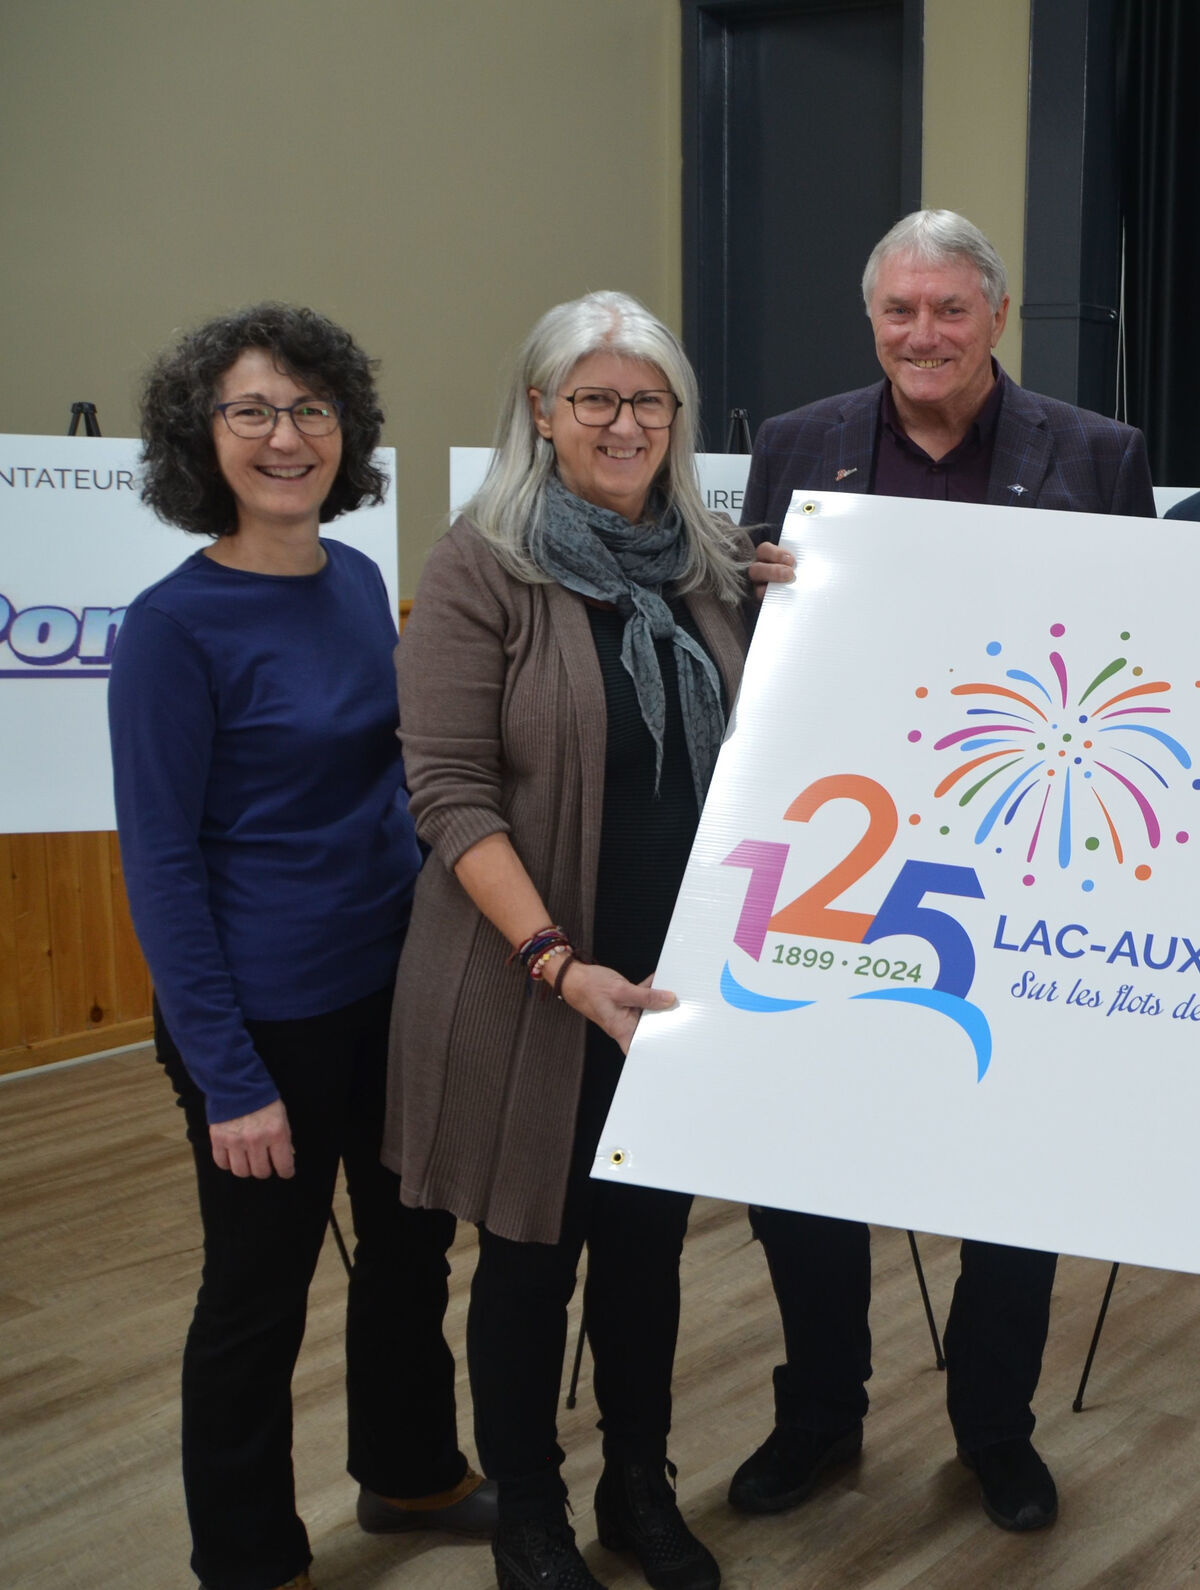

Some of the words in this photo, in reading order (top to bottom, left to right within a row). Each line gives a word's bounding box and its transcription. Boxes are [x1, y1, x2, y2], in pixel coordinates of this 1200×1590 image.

[720, 773, 986, 1000] 125
[771, 944, 834, 970] 1899
[854, 956, 922, 983] 2024
[1011, 970, 1059, 1002] Sur
[1066, 978, 1103, 1008] les
[1106, 984, 1164, 1017] flots
